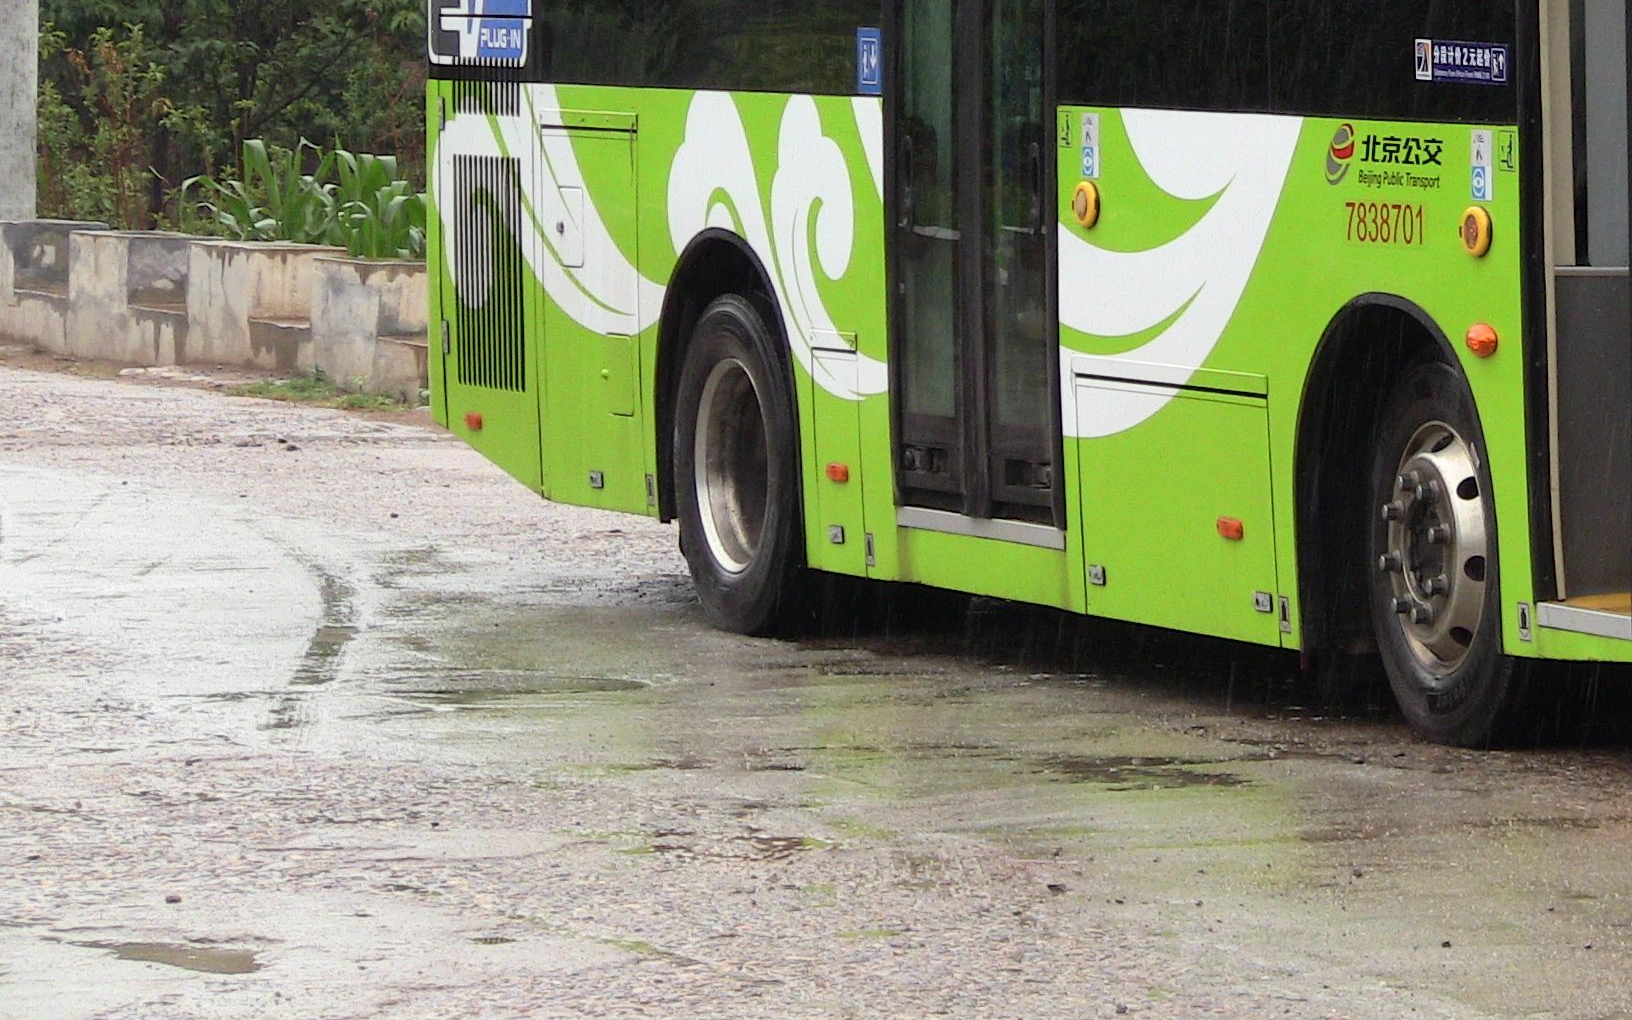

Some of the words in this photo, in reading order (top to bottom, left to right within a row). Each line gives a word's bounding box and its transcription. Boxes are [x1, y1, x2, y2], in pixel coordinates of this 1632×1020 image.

[480, 28, 521, 49] PLUG-IN
[1360, 135, 1443, 165] 北京公交
[1358, 170, 1382, 188] Beijing
[1383, 171, 1404, 186] Public
[1405, 172, 1440, 190] Transport
[1345, 202, 1424, 244] 7838701
